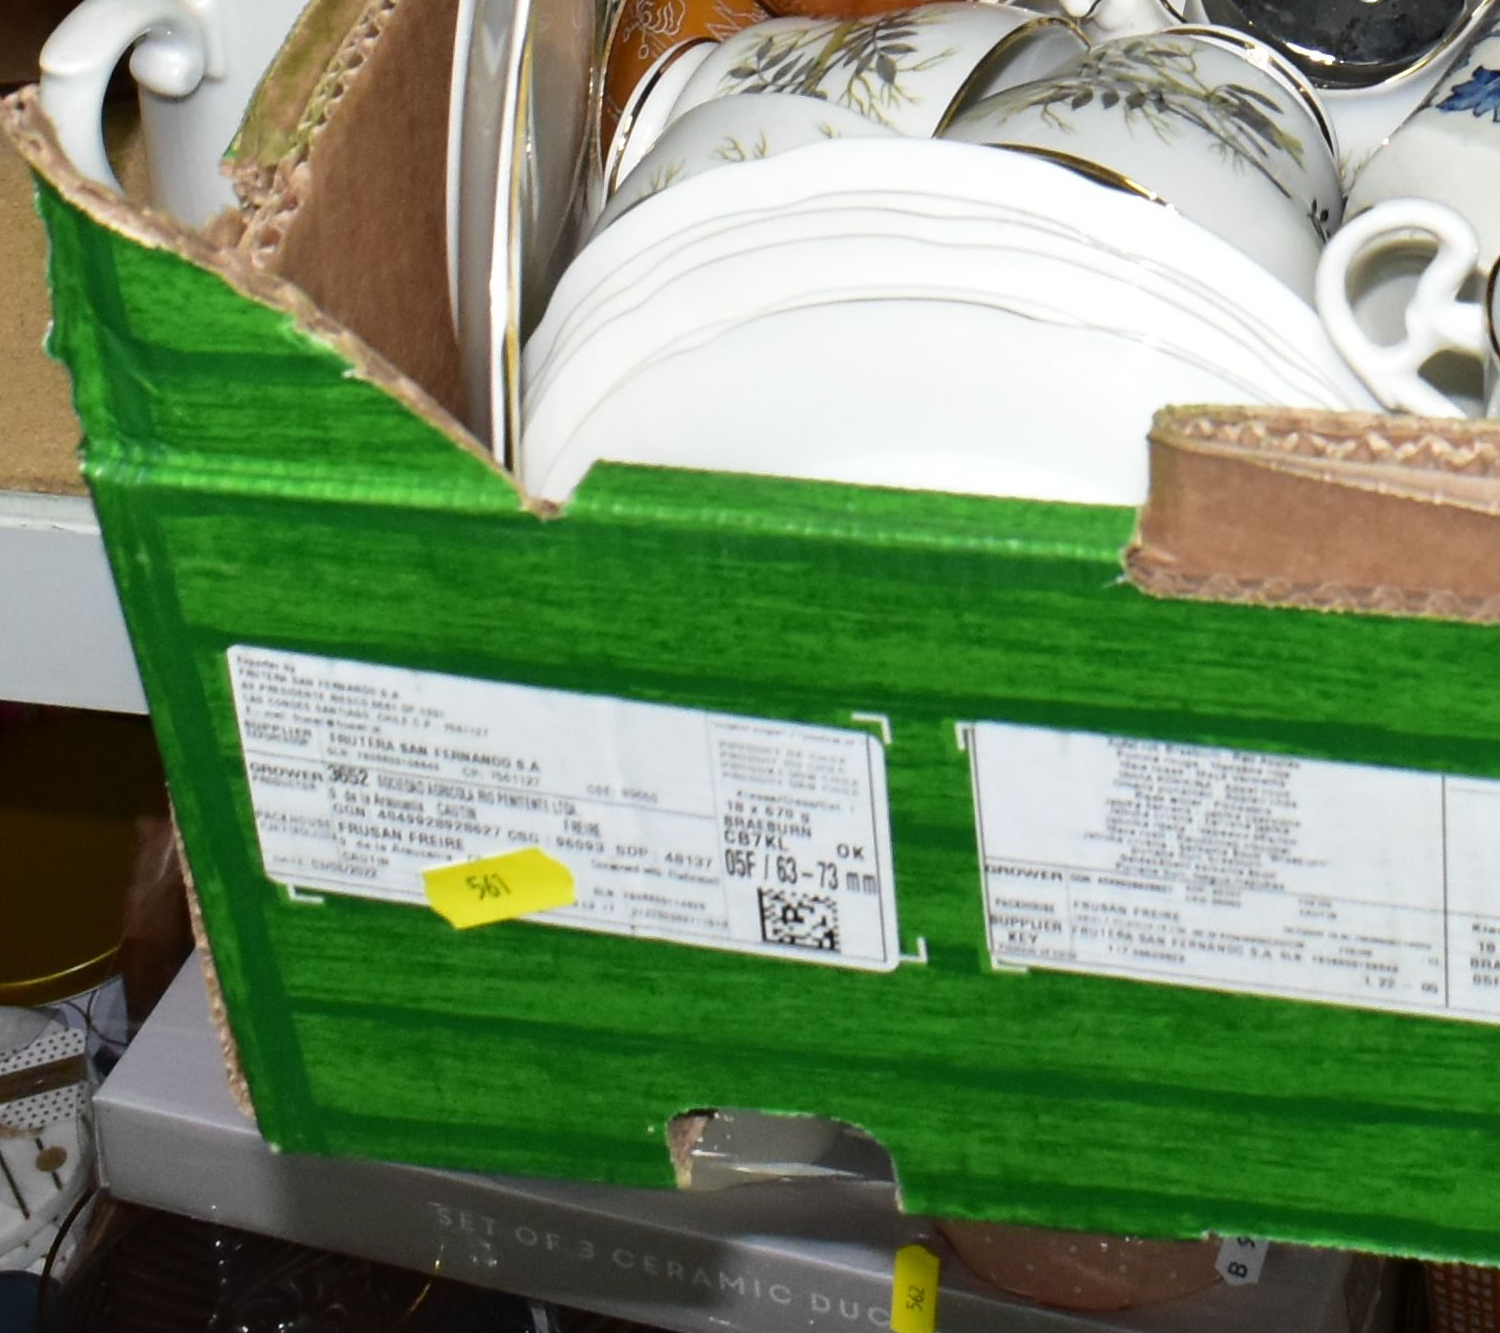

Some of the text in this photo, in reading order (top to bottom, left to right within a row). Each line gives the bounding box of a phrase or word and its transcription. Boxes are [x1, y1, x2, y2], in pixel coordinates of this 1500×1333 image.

[249, 761, 323, 783] GROWER
[326, 763, 369, 787] 3652
[337, 820, 402, 842] FRUSAN
[407, 830, 465, 851] FREIRE
[723, 814, 813, 839] BRAEBURN
[723, 830, 866, 861] CB7KL OK
[464, 873, 513, 901] 561
[844, 869, 880, 895] mm
[434, 1205, 498, 1236] SET
[515, 1226, 563, 1250] OF
[578, 1238, 595, 1261] 3
[610, 1245, 794, 1306] CERAMIC
[1227, 1261, 1248, 1278] B
[905, 1284, 926, 1312] 562
